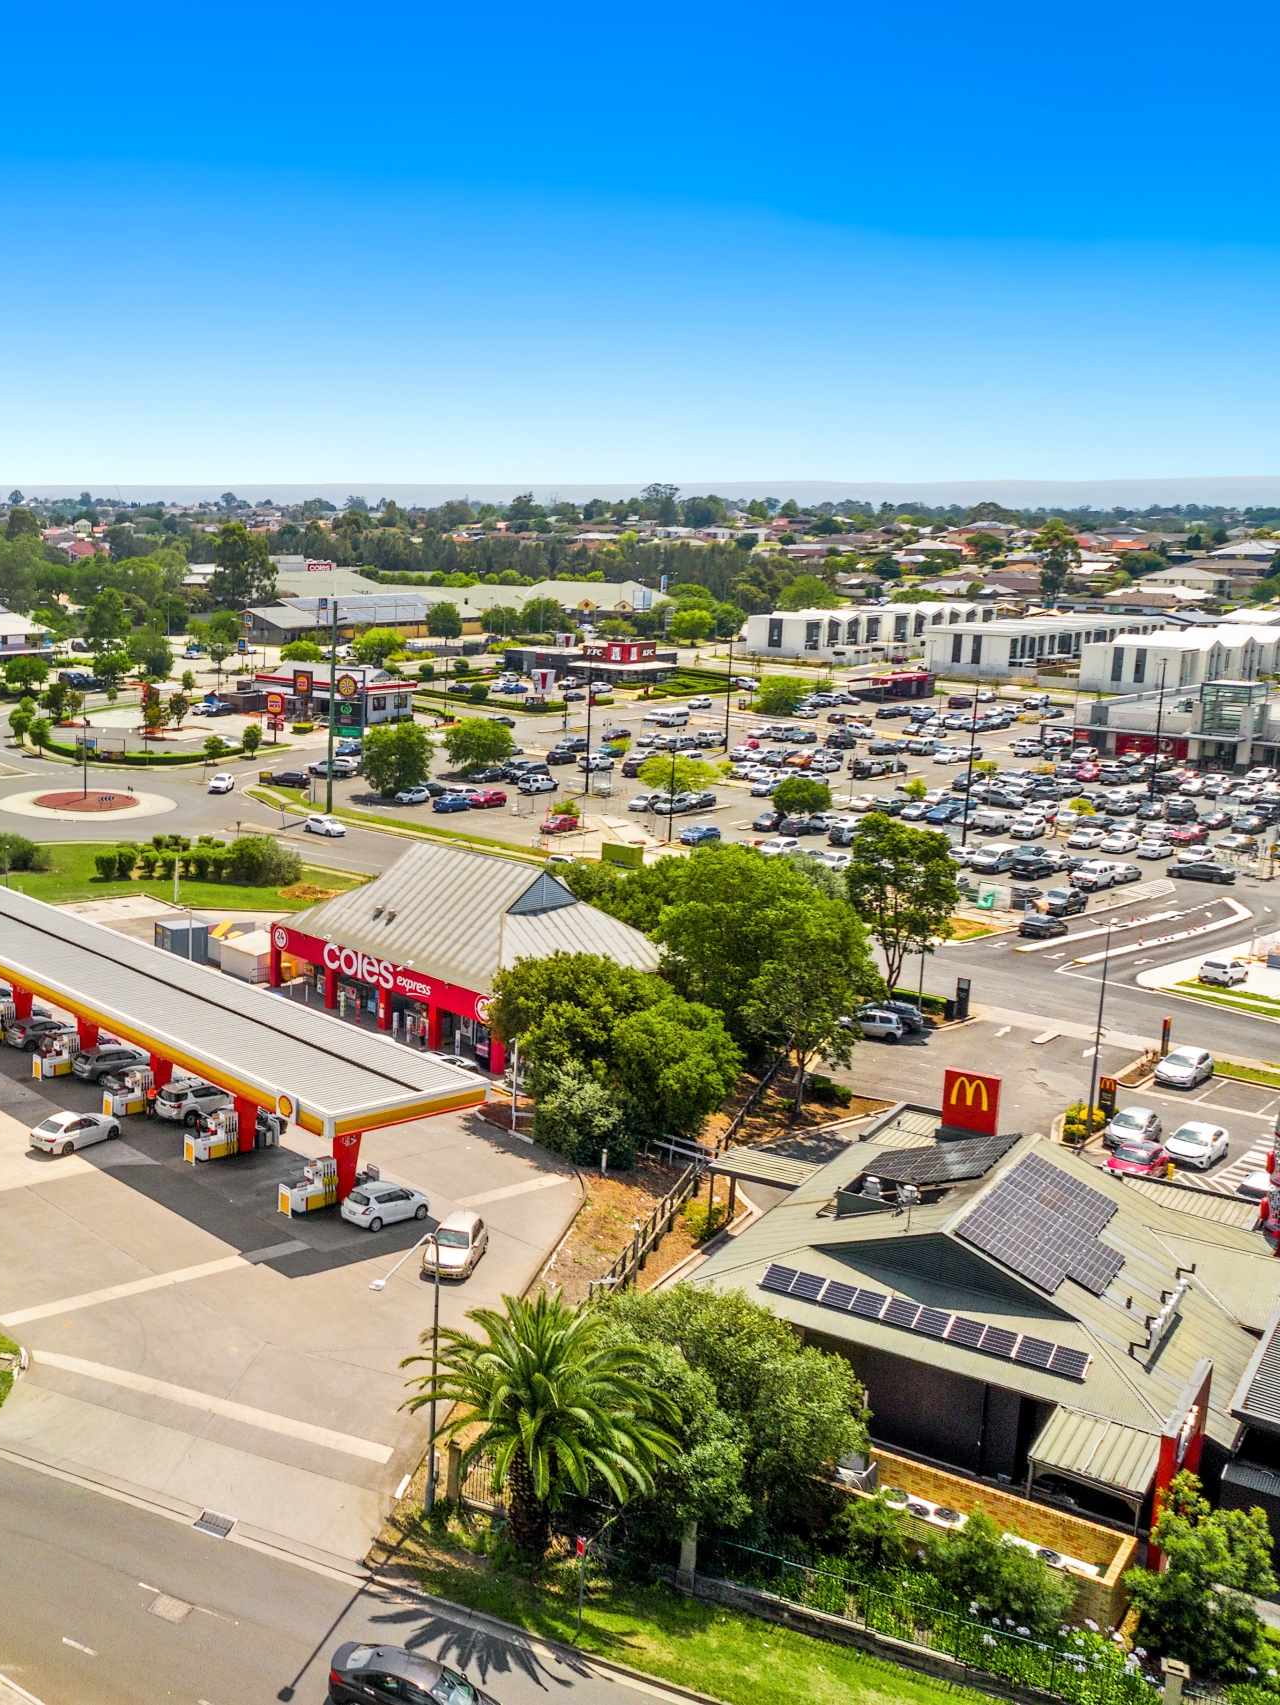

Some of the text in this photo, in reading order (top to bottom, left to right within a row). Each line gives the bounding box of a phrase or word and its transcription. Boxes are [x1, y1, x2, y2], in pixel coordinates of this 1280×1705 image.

[276, 930, 284, 941] 24
[323, 942, 432, 996] coles express
